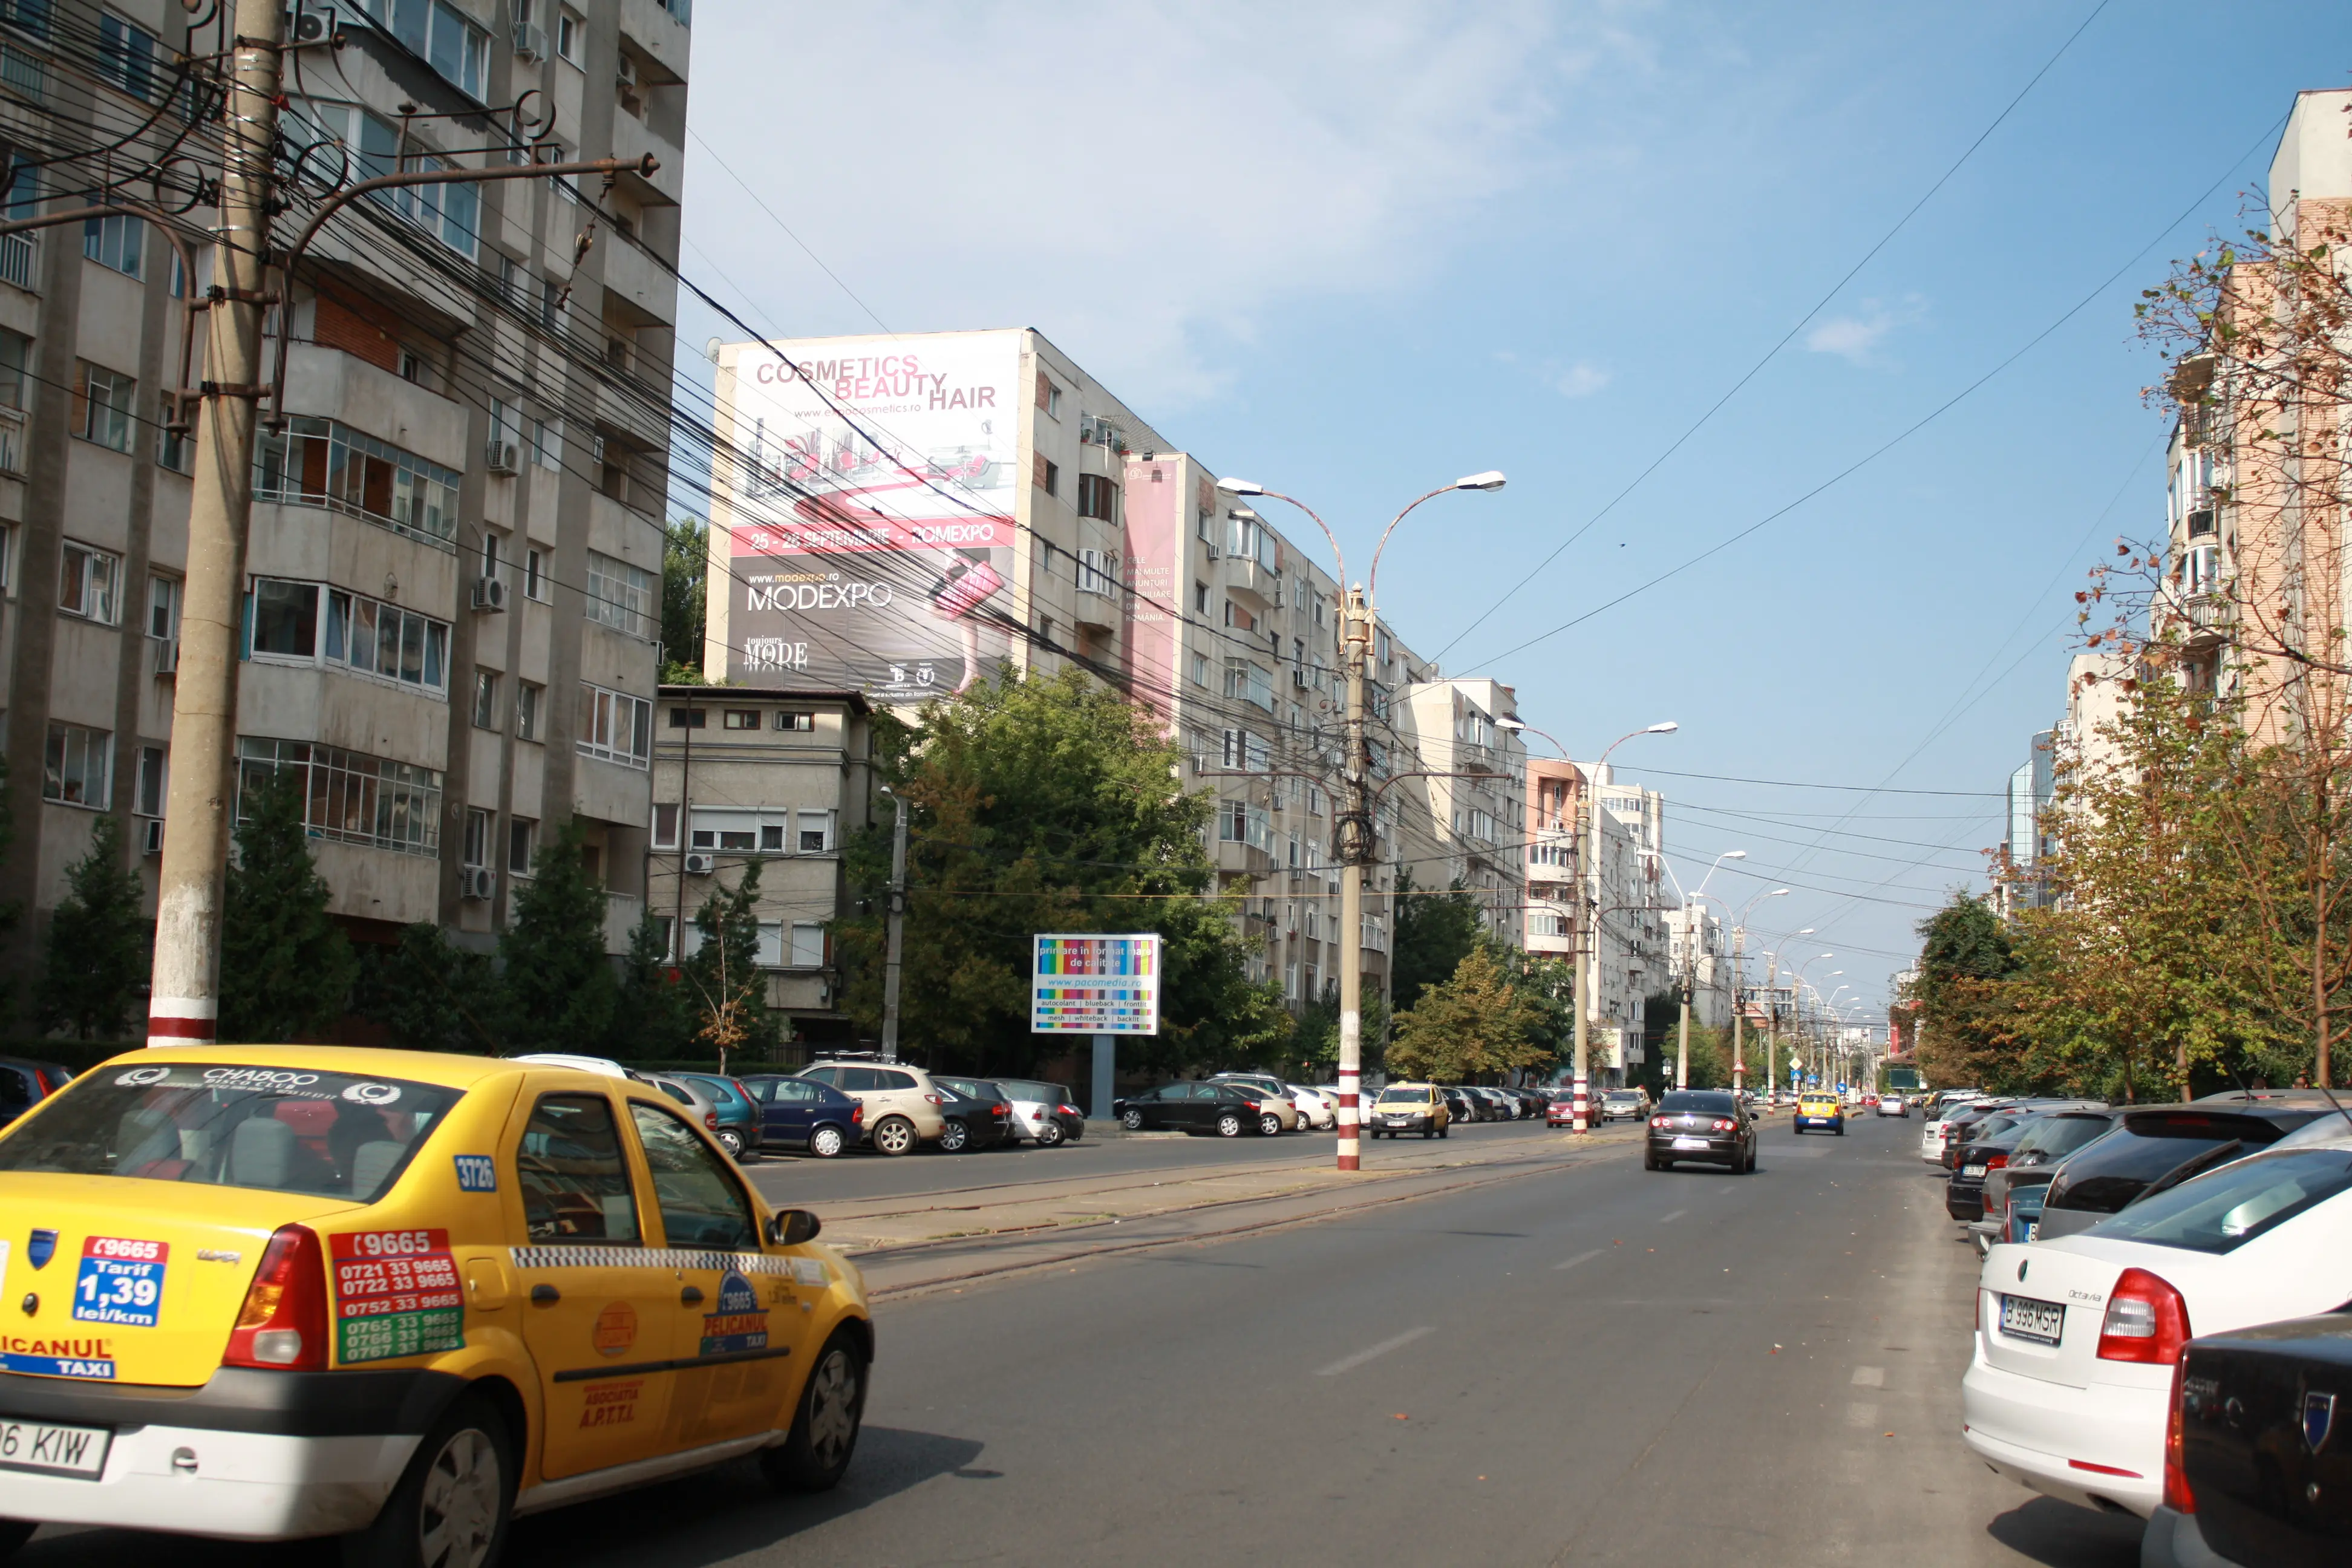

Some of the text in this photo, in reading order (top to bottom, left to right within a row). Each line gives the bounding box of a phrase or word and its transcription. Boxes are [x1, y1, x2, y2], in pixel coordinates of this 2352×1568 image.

[757, 354, 918, 384] COSMETICS
[834, 373, 947, 400] BEAUTY
[929, 387, 996, 411] HAIR
[794, 403, 921, 418] www.expocosmetics.ro
[750, 533, 769, 550] 25
[912, 523, 995, 544] ROMEXPO
[748, 573, 840, 584] www.modexpo.ro
[747, 582, 893, 612] MODEXPO
[747, 635, 782, 648] toujours
[743, 642, 808, 665] MODE
[1040, 947, 1077, 956] prinare
[1093, 947, 1125, 956] format
[1070, 958, 1121, 967] de calitate
[1048, 978, 1142, 988] www.pacomedia.ro
[203, 1068, 319, 1086] CHABOO
[205, 1078, 252, 1087] DISCO
[257, 1080, 296, 1089] CLUB
[457, 1157, 495, 1189] 3726
[104, 1239, 159, 1260] 9665
[363, 1232, 430, 1256] 9665
[94, 1260, 153, 1277] Tarif
[340, 1259, 452, 1280] 0721 33 9665
[79, 1273, 158, 1307] 1,39
[342, 1273, 456, 1295] 0722 33 9665
[345, 1294, 459, 1316] 0752 33 9665
[728, 1291, 751, 1310] 9665
[2068, 1289, 2102, 1302] Octavia
[76, 1306, 153, 1325] lei/km
[346, 1312, 459, 1335] 0765 33 9665
[704, 1313, 768, 1337] PELICANUL
[2005, 1298, 2059, 1334] B 996 MSR
[346, 1325, 459, 1348] 0766 33 9665
[746, 1334, 766, 1348] TAXI
[346, 1337, 459, 1361] 0767 33 9665
[57, 1361, 111, 1377] TAXI
[31, 1426, 91, 1465] KIW
